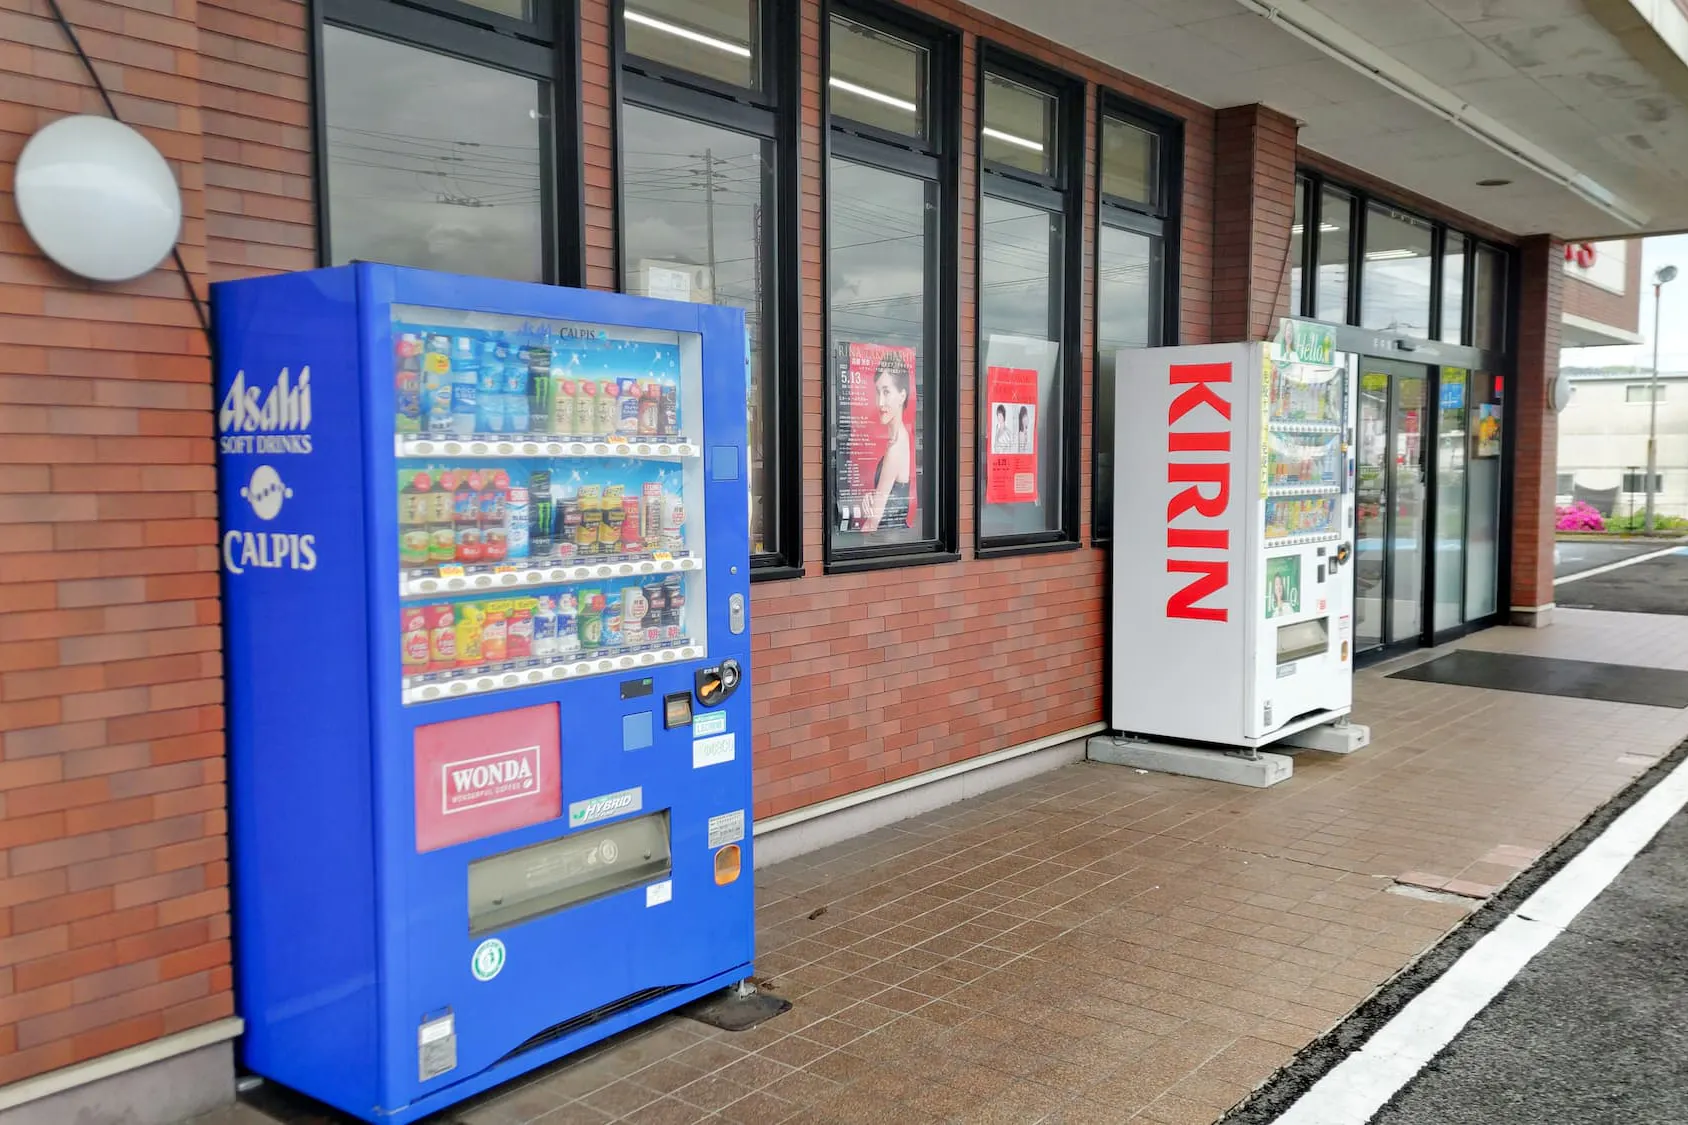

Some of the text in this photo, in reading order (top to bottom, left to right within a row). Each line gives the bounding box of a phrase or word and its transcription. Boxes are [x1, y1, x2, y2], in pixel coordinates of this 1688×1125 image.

[560, 327, 595, 341] CALPIS
[841, 370, 861, 384] 5.13
[219, 365, 312, 432] Asahi
[220, 435, 313, 454] SOFT DRINKS
[1167, 361, 1232, 622] KIRIN
[223, 530, 317, 574] CALPIS
[453, 757, 532, 792] WONDA
[583, 795, 631, 821] HYBRID
